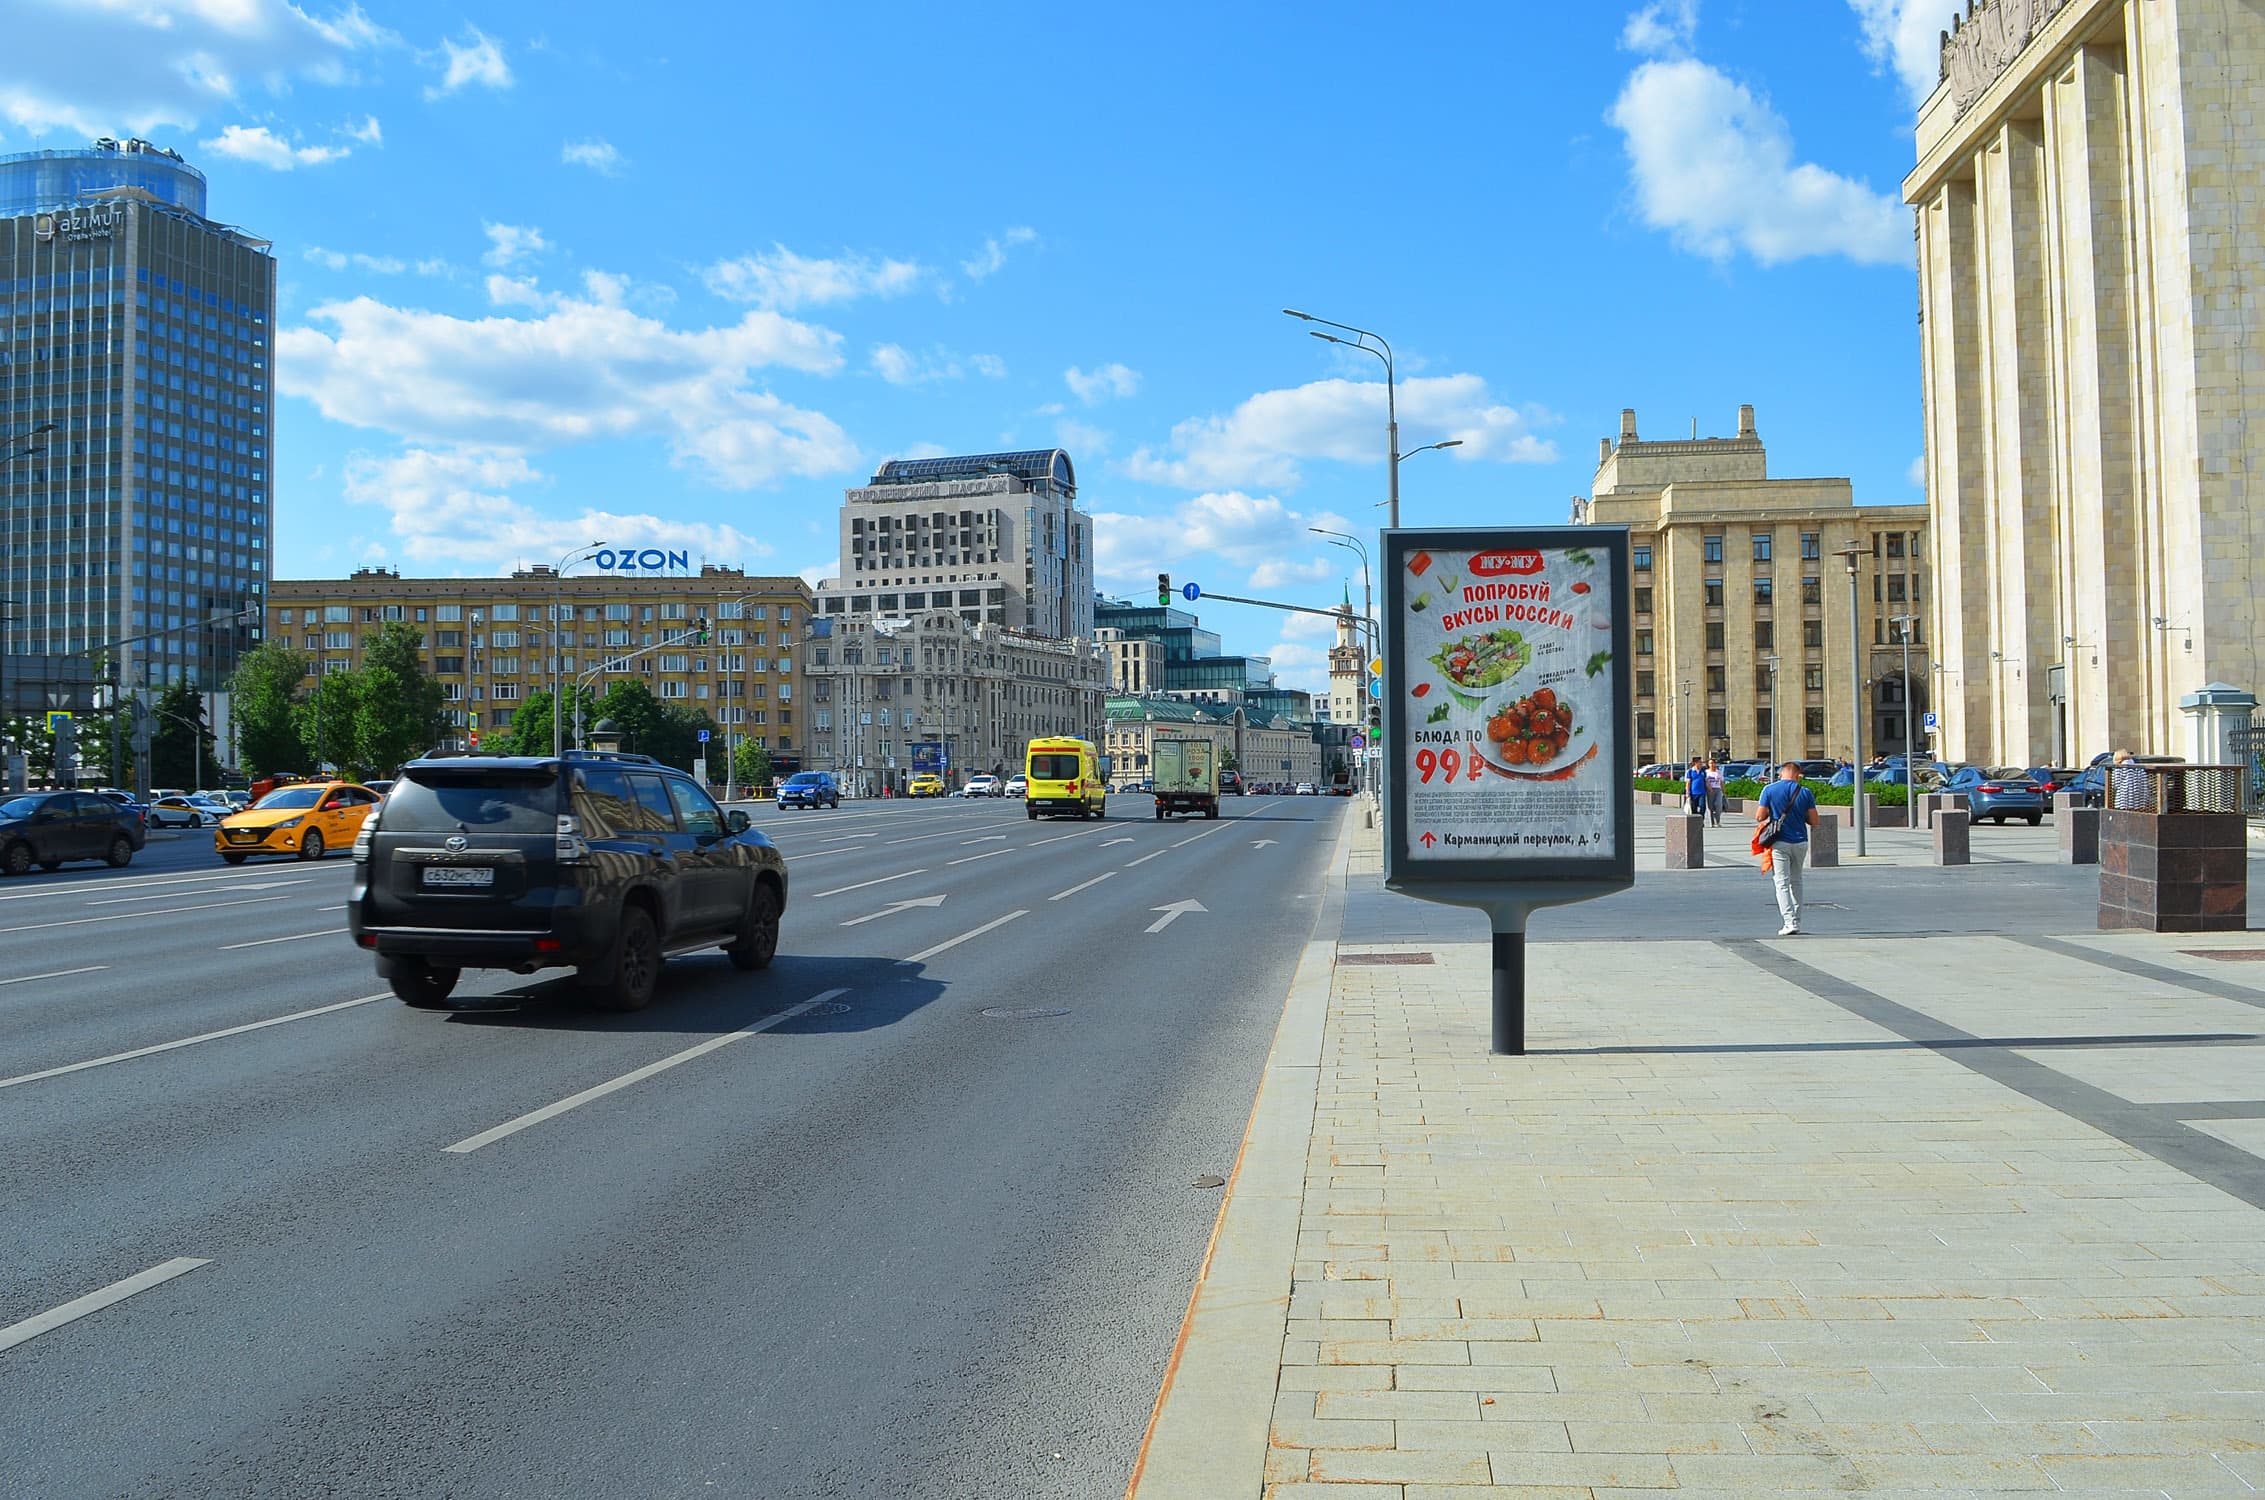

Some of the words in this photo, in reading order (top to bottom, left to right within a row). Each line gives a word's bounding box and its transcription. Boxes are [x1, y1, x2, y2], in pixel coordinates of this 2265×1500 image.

[596, 549, 688, 569] OZON
[1463, 581, 1549, 603] ПОПРОБУЙ
[1442, 604, 1499, 631] ВКУСЫ
[1505, 604, 1574, 630] РОССИИ
[1415, 730, 1461, 744] БЛЮДА
[1466, 730, 1482, 742] ПО
[1416, 748, 1461, 785] 99
[1444, 832, 1520, 849] Карманицкий
[1523, 834, 1575, 848] переулок,
[1578, 834, 1589, 847] д.
[1593, 832, 1601, 845] 9
